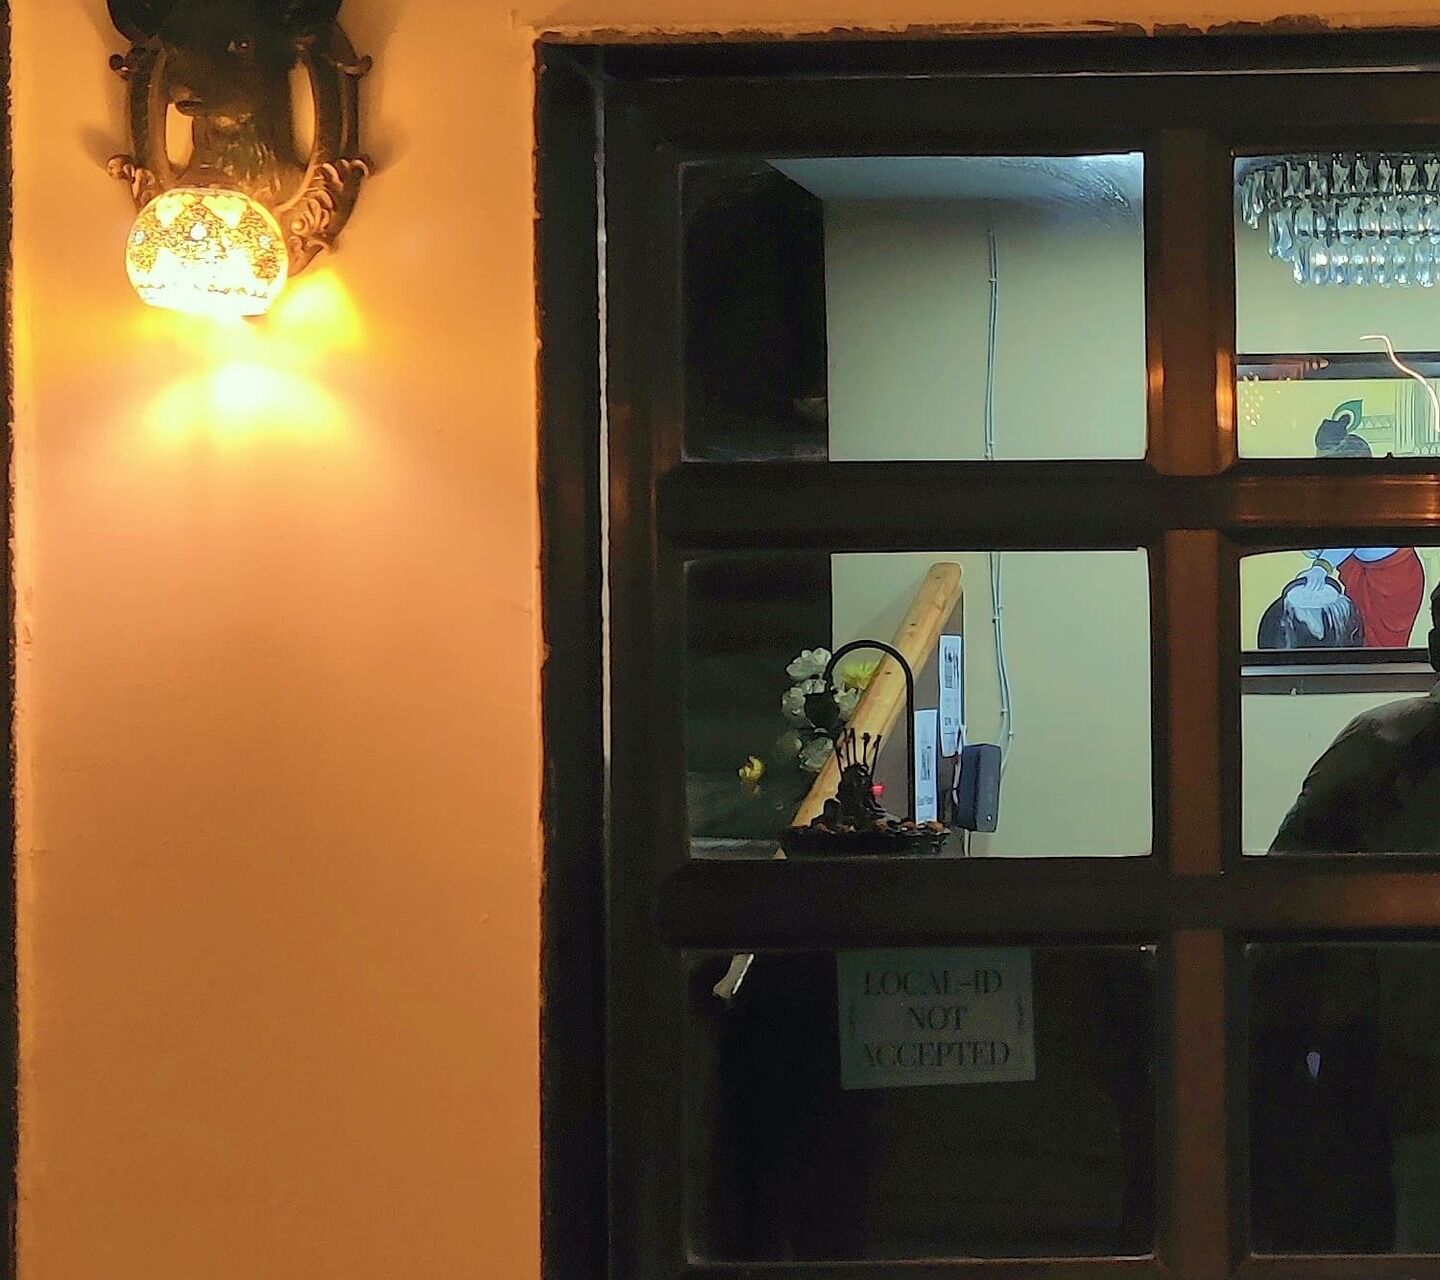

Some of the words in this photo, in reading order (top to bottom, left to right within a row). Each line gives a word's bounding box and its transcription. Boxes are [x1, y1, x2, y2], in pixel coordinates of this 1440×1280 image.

[864, 969, 1003, 996] LOCAL-ID
[908, 1006, 968, 1031] NOT
[864, 1041, 1011, 1067] ACCEPTED
